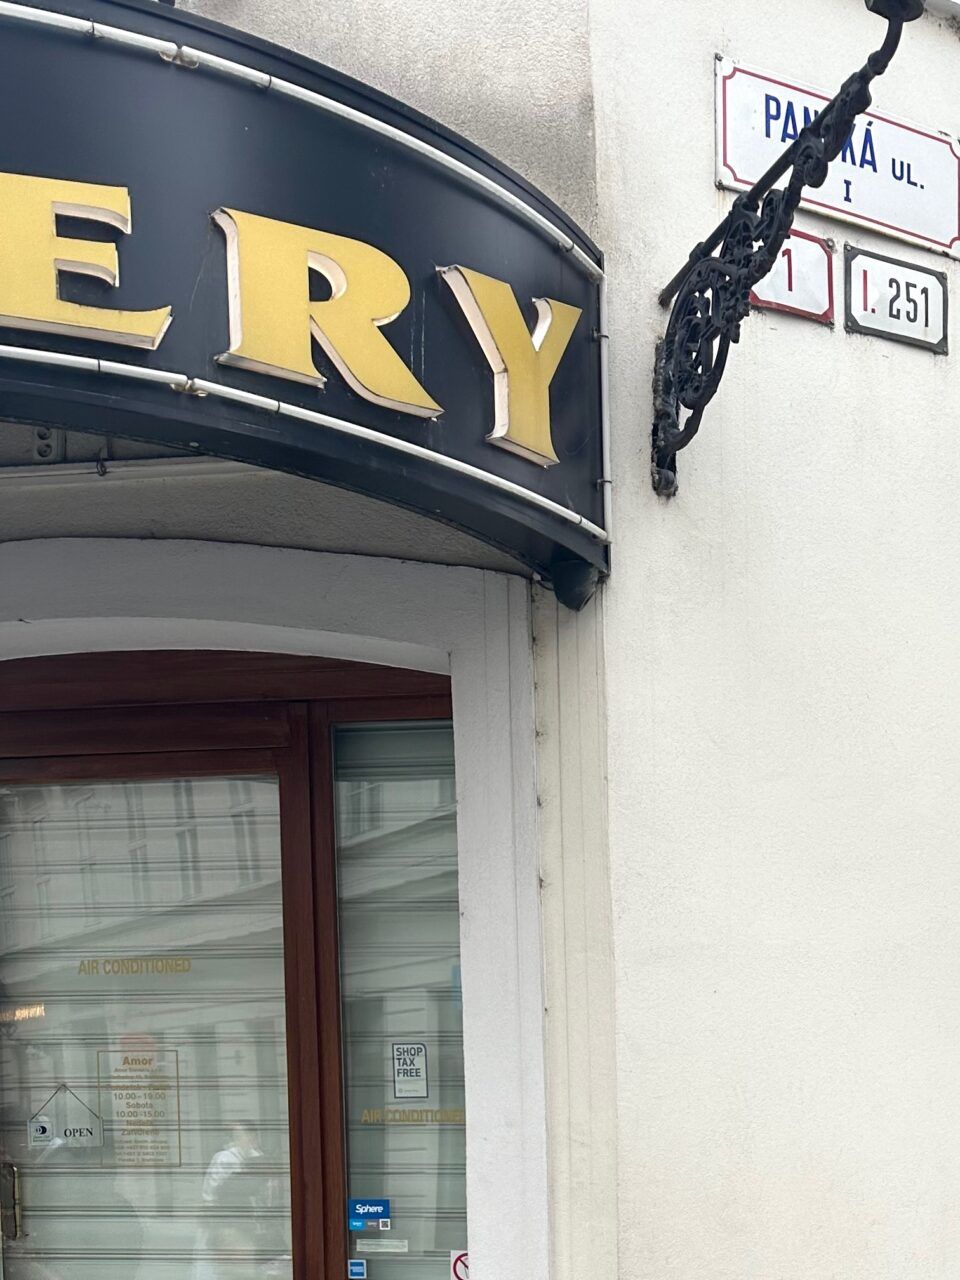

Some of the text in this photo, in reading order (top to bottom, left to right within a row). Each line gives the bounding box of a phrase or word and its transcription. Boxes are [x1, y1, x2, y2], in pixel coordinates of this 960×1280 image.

[764, 92, 925, 190] PAKÁ UL.
[888, 277, 930, 328] 251
[0, 171, 583, 469] ERY
[78, 958, 192, 976] AIR CONDITIONED
[396, 1046, 423, 1057] SHOP
[396, 1057, 416, 1068] TAX
[396, 1067, 421, 1078] FREE
[64, 1128, 93, 1138] OPEN
[355, 1203, 384, 1215] Sphere
